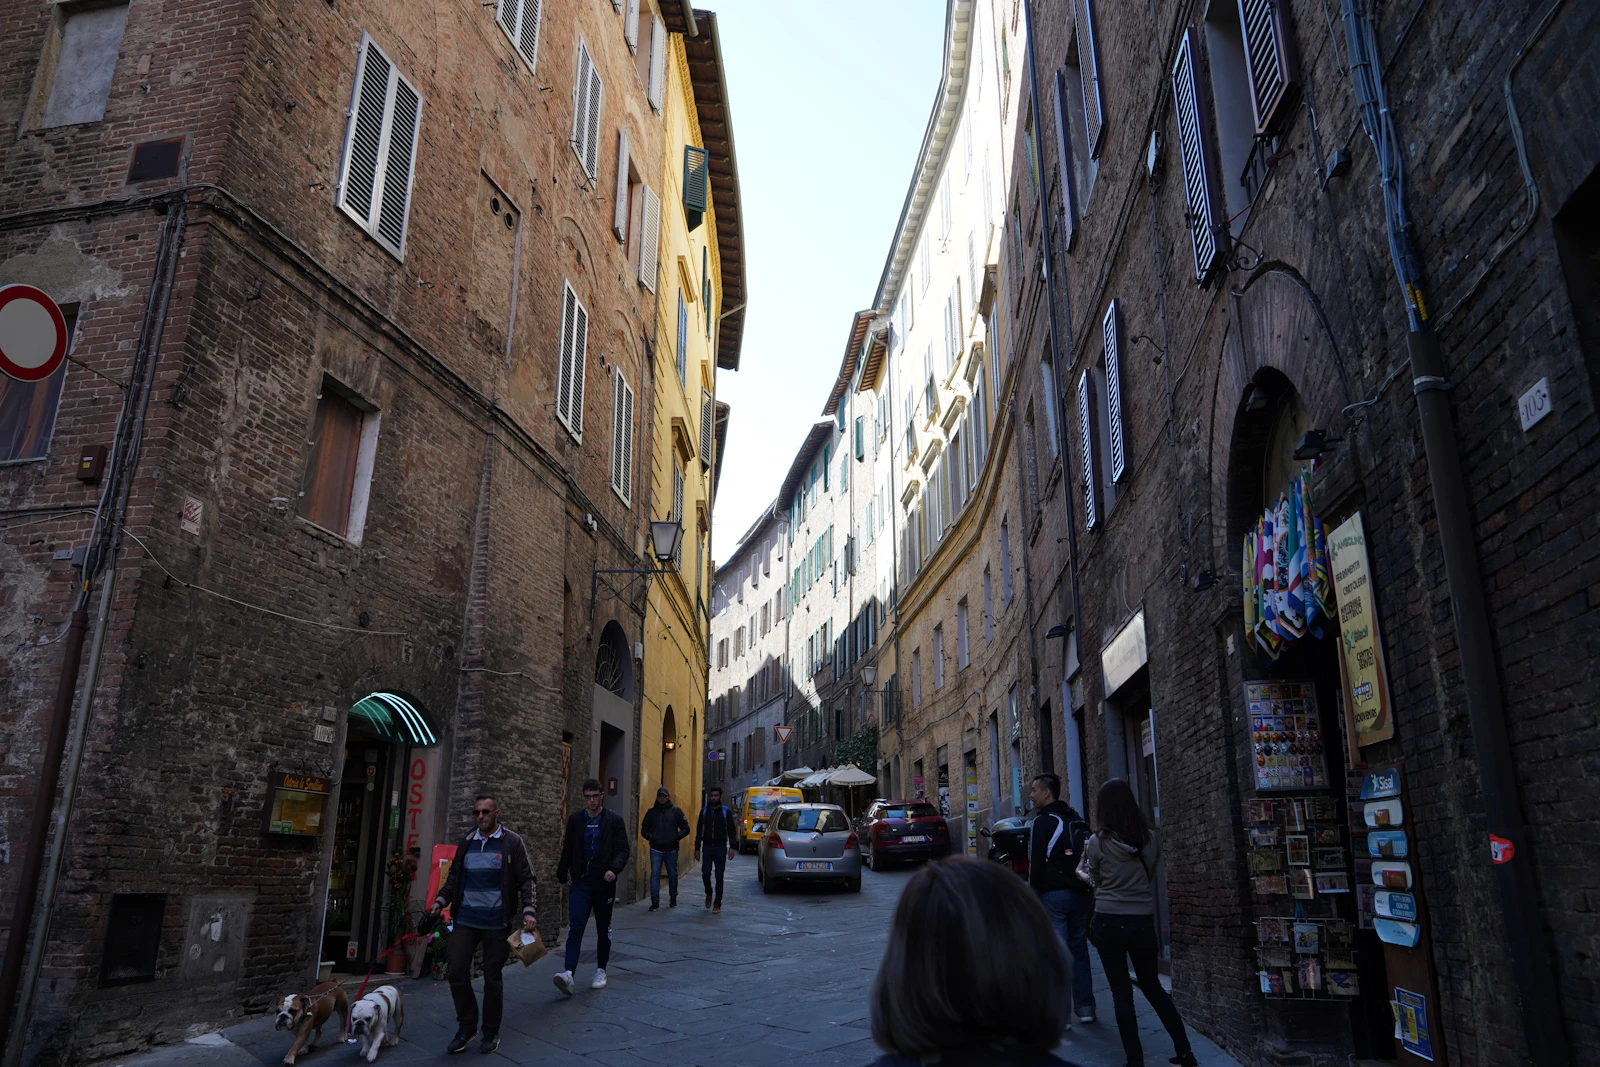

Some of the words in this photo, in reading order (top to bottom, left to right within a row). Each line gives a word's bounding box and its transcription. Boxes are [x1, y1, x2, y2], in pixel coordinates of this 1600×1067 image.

[1525, 390, 1544, 421] 103
[1336, 560, 1361, 583] FERRAMENTA
[1343, 574, 1367, 596] CARTOLERIA
[1341, 605, 1363, 624] ELETTRICO
[1357, 646, 1374, 662] CENTRO
[1358, 656, 1374, 671] SERVIZI
[1355, 708, 1377, 724] SOUVENIRS
[1379, 774, 1394, 790] Sisal
